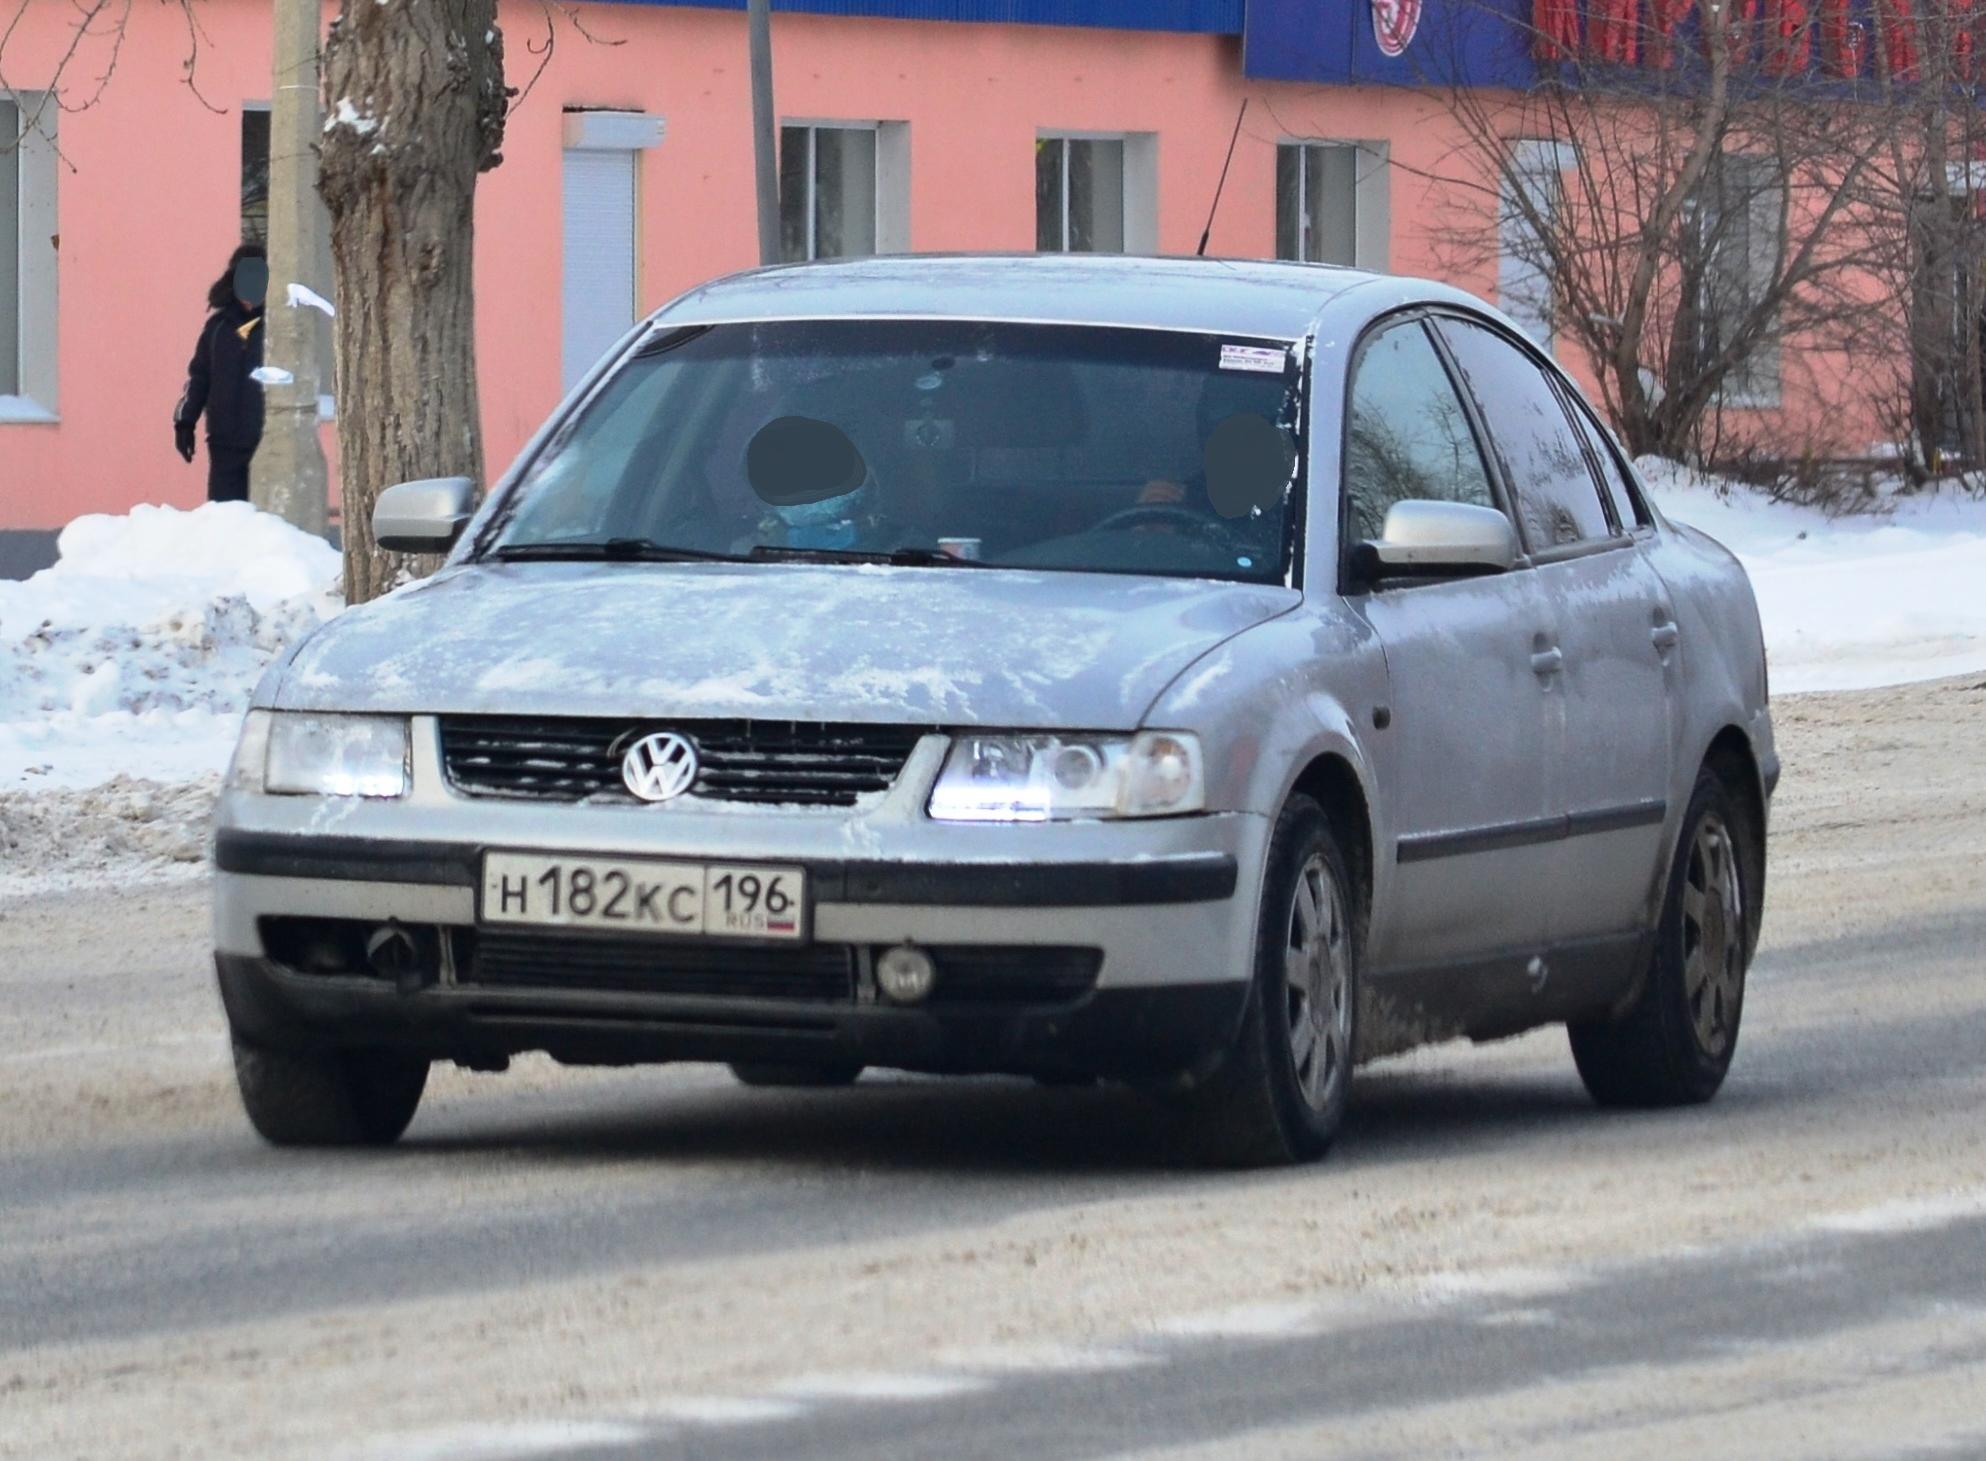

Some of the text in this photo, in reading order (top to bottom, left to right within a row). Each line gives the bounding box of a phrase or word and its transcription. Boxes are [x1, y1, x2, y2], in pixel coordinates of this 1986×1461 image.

[623, 732, 697, 800] VW
[501, 865, 790, 923] Н182КС 196
[727, 910, 764, 929] RUS
